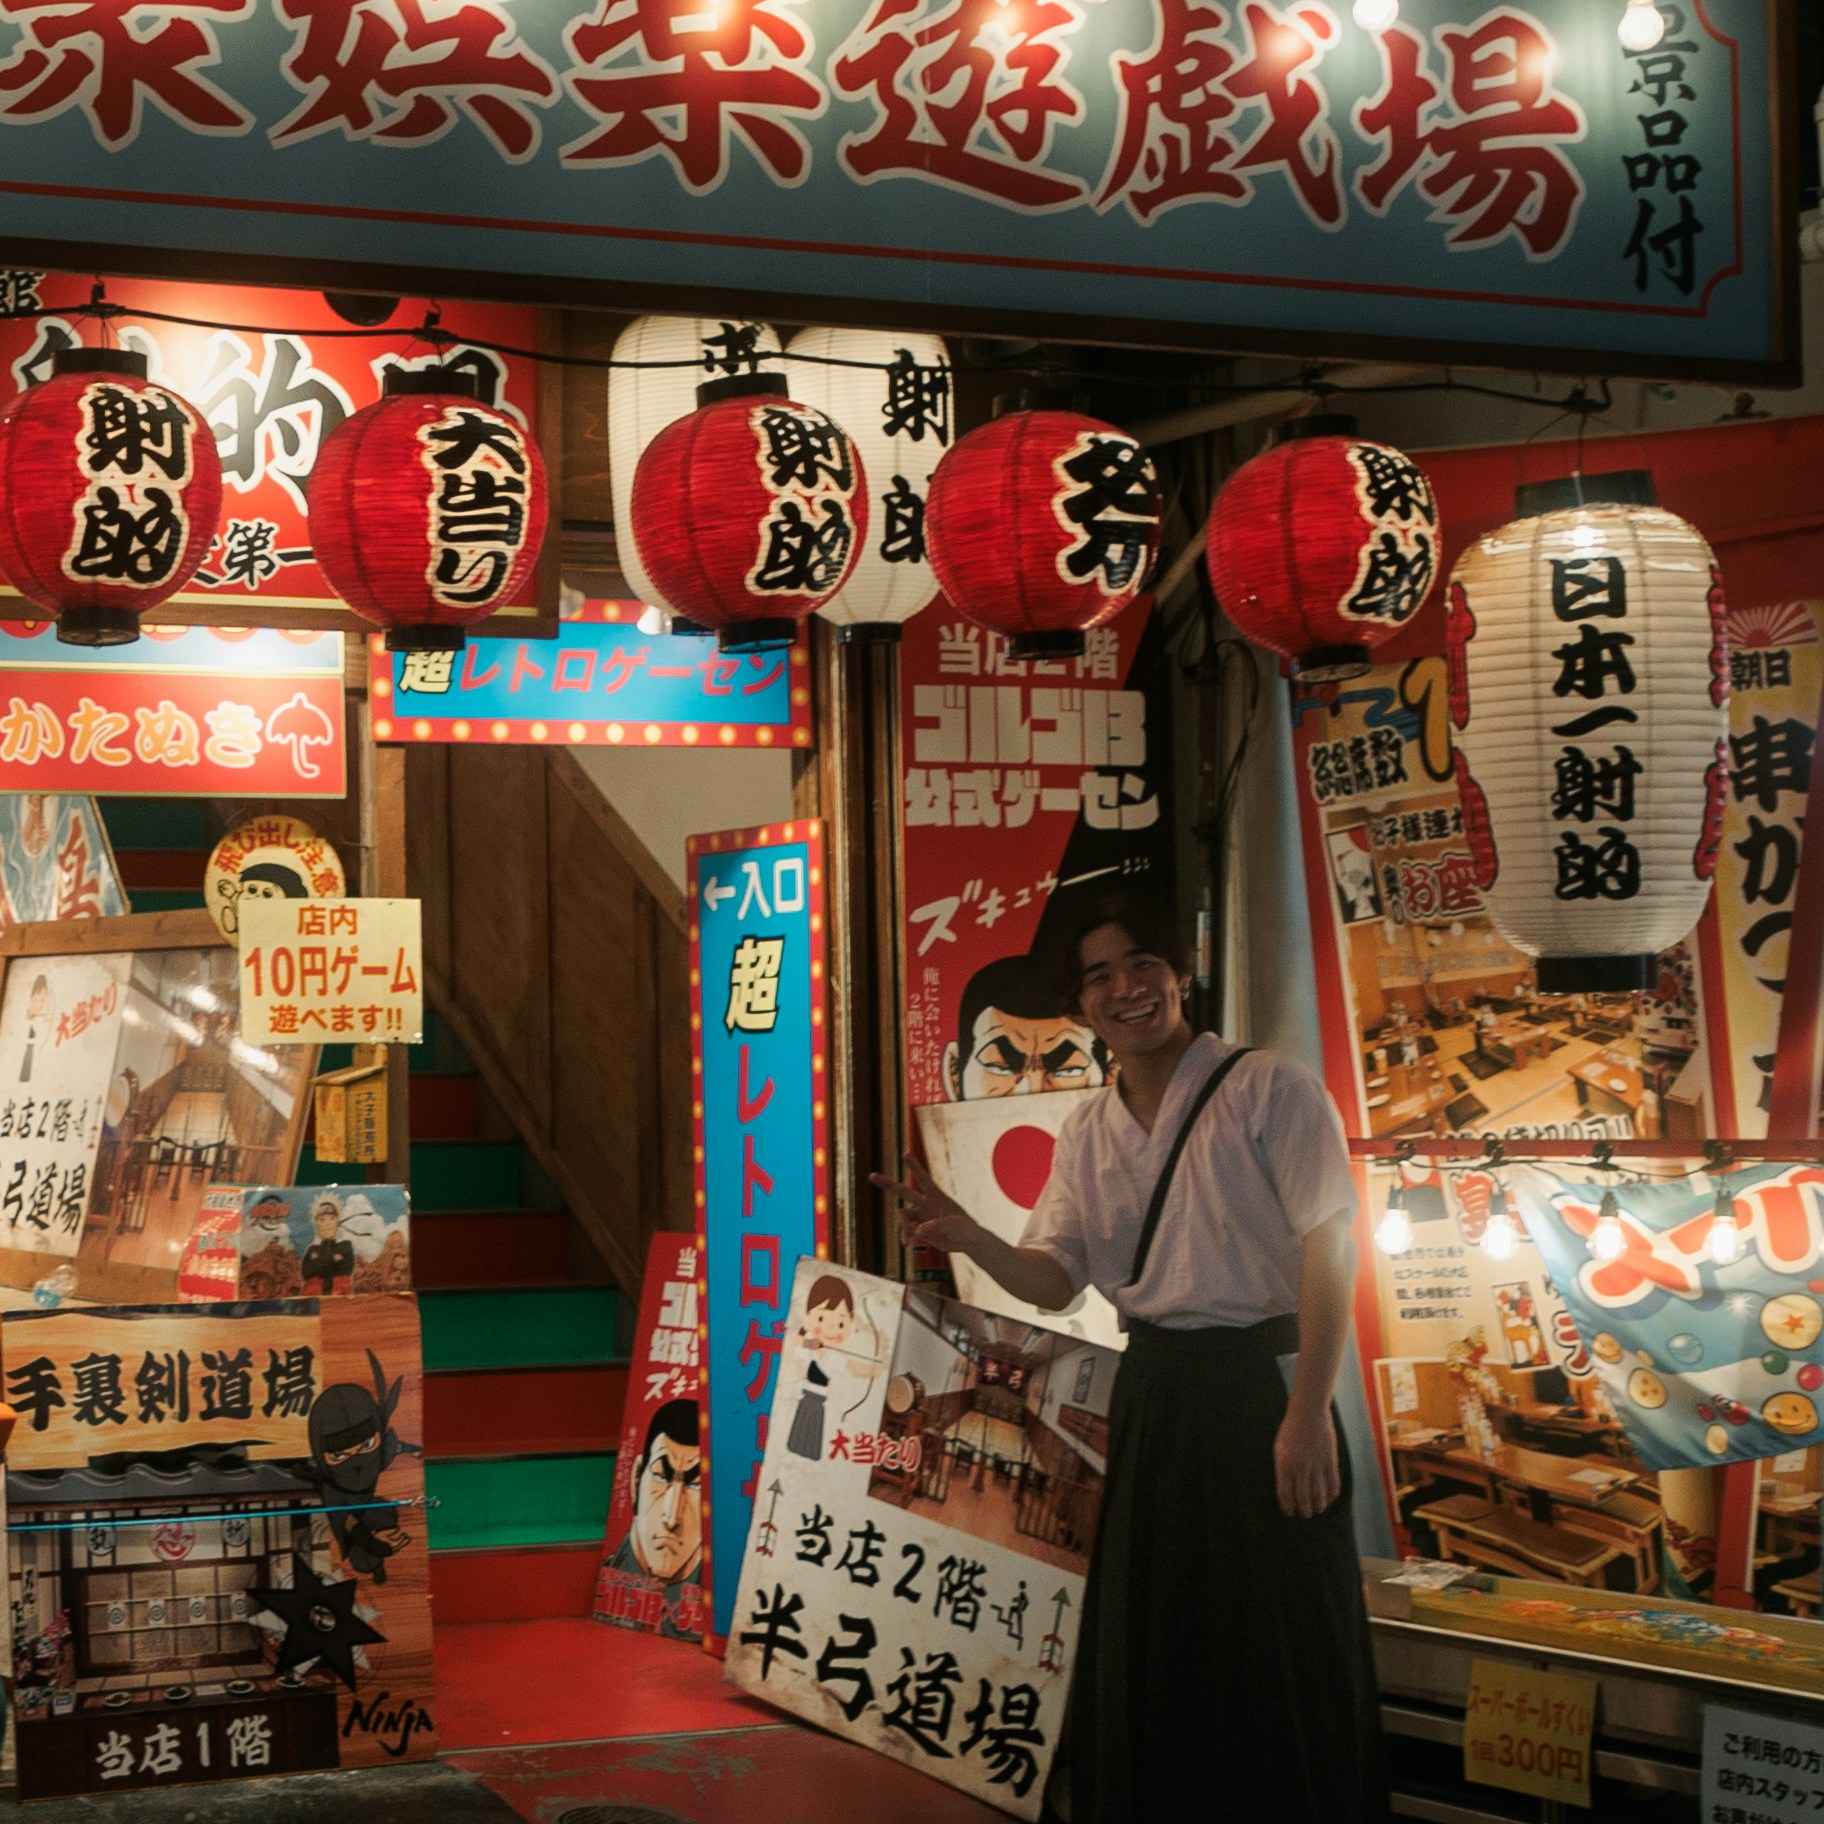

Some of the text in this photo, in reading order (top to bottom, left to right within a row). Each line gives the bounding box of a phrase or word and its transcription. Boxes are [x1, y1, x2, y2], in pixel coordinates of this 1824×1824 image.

[429, 411, 526, 602] 大当り
[398, 644, 786, 698] 超レトロゲーセン
[0, 697, 263, 768] かたぬき
[904, 768, 1161, 831] 公式ゲーセン
[297, 904, 359, 936] 店内
[737, 857, 807, 922] 入口
[244, 945, 418, 998] 10円ゲーム
[269, 1004, 403, 1034] 遊べます!!
[0, 1096, 74, 1143] 当店2階
[6, 1344, 316, 1433] 手裏剣道場
[828, 1428, 923, 1473] 大当たり
[794, 1503, 988, 1633] 当店2階
[740, 1582, 1045, 1798] 半弓道場
[93, 1713, 275, 1780] 当店1階
